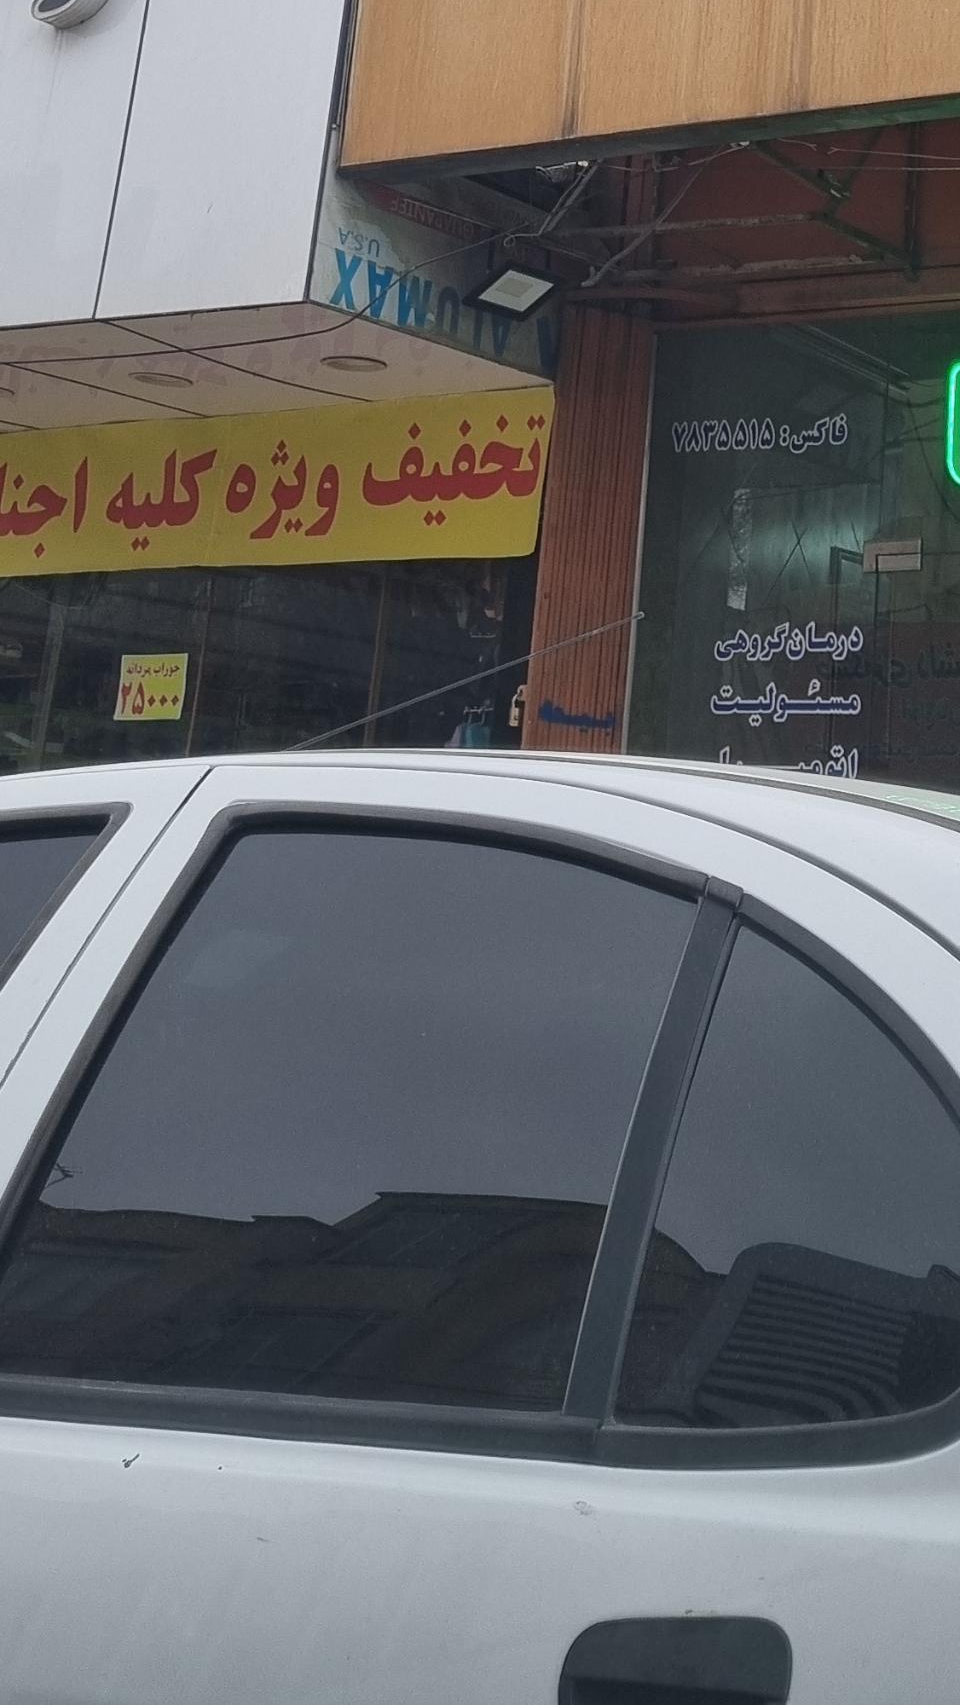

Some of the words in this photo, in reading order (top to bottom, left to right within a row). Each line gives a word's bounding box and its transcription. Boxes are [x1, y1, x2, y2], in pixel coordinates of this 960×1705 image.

[671, 416, 775, 454] ۷۸۳۵۵۱۵
[225, 439, 340, 540] ویژه
[362, 414, 548, 528] تخفیف
[105, 448, 218, 552] کلیه
[714, 621, 790, 661] گروهی
[786, 620, 864, 661] درمان
[153, 662, 181, 678] جوراب
[120, 681, 180, 715] ۲۵۰۰۰
[710, 678, 862, 727] مسئولیت
